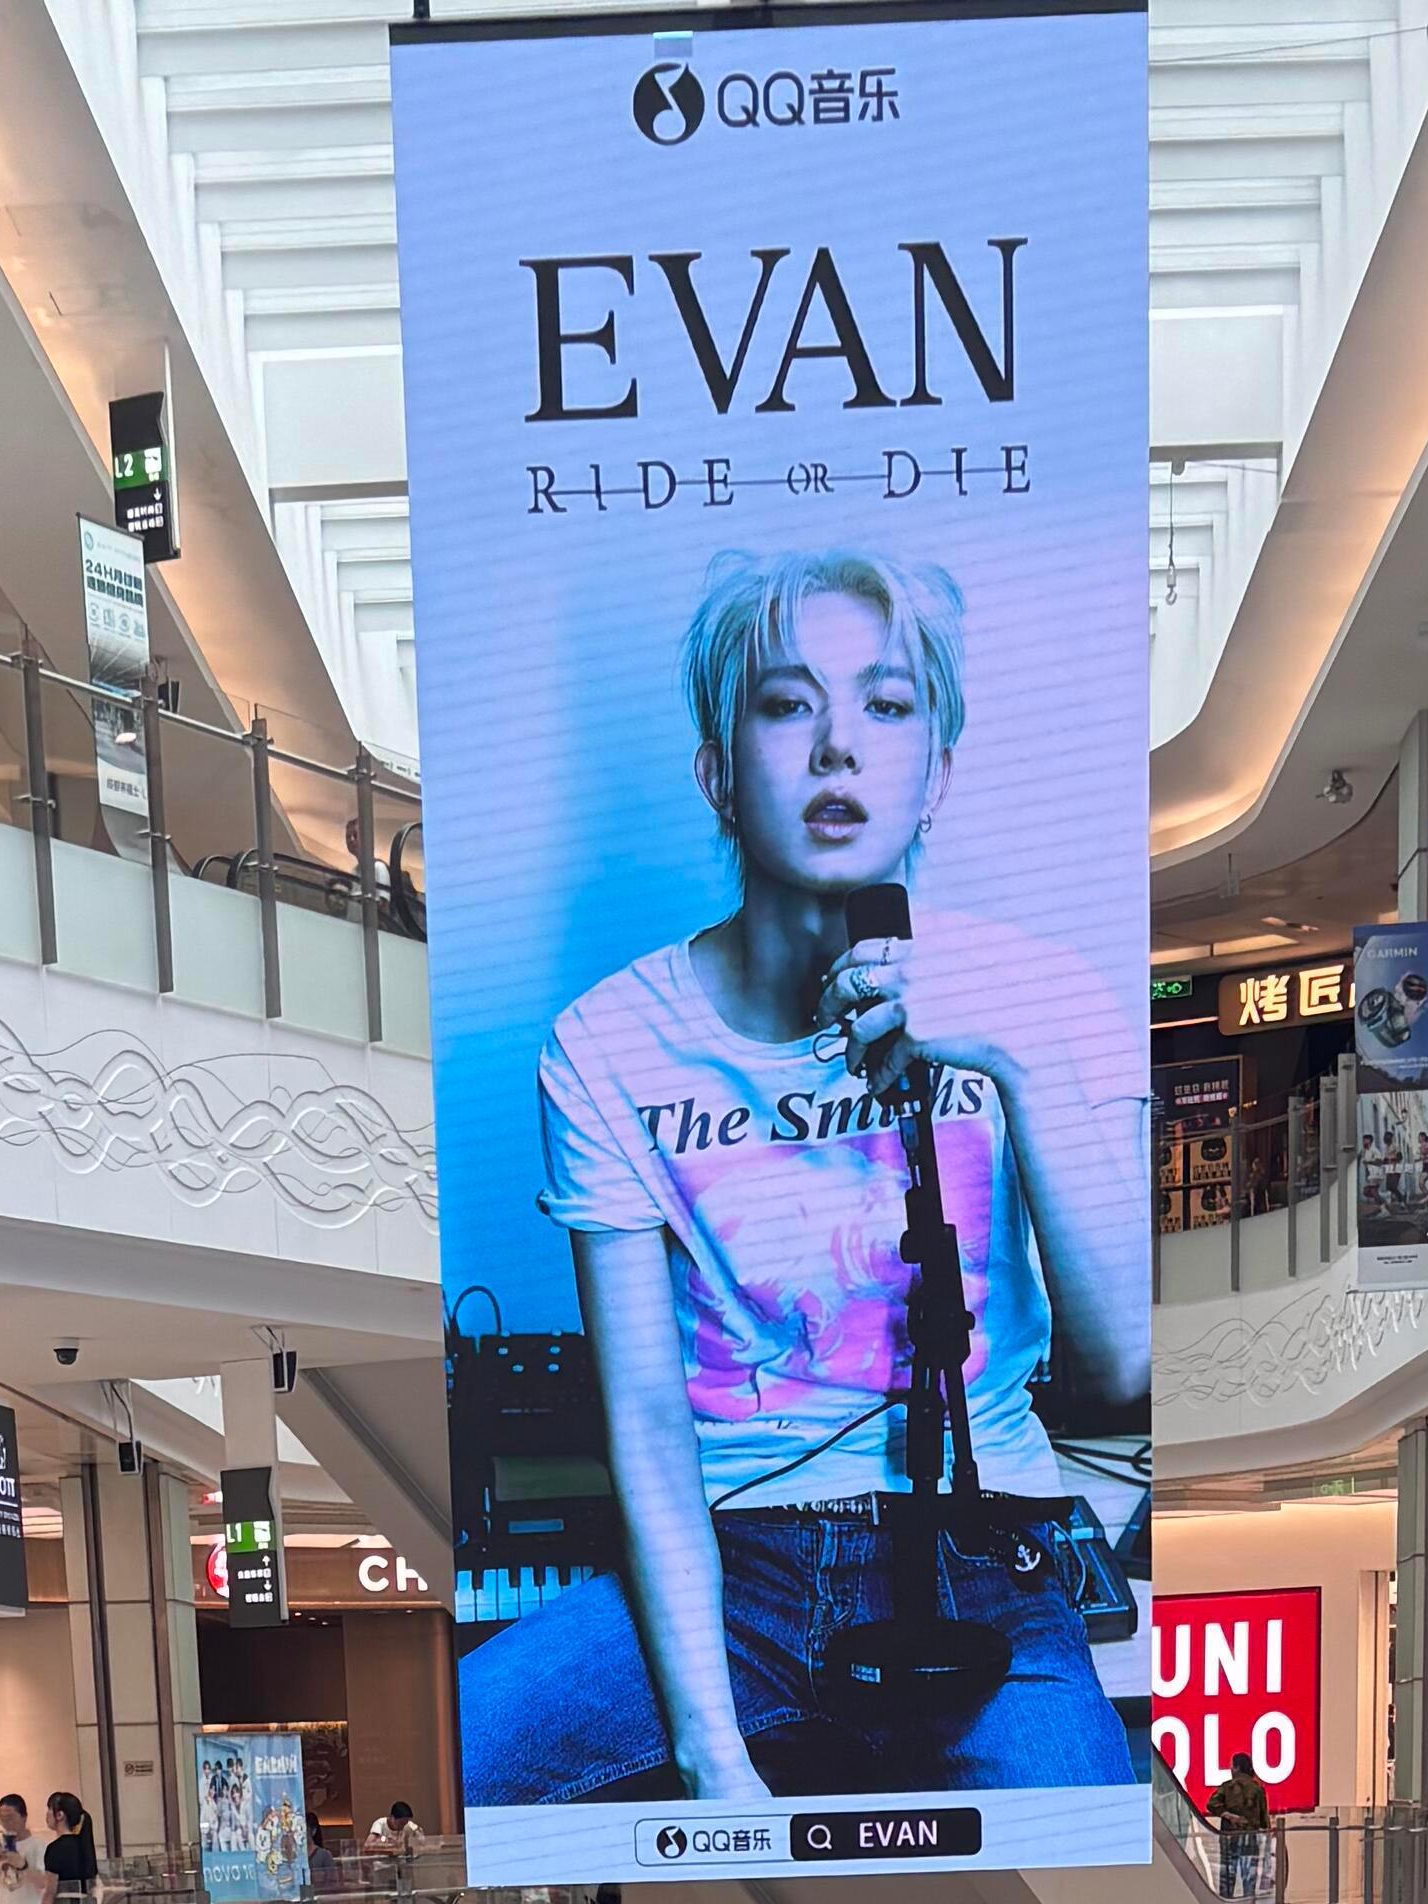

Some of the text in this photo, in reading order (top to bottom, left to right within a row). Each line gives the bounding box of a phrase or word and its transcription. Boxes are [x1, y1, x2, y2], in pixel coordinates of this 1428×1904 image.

[716, 67, 900, 129] QQ音乐
[518, 237, 1028, 423] EVAN
[526, 457, 734, 514] RIDE
[882, 445, 1030, 499] DIE
[1239, 965, 1355, 1026] 烤匠
[635, 1093, 750, 1155] The
[1152, 1619, 1283, 1697] UNI
[692, 1824, 772, 1855] QQ音乐
[858, 1819, 938, 1849] EVAN
